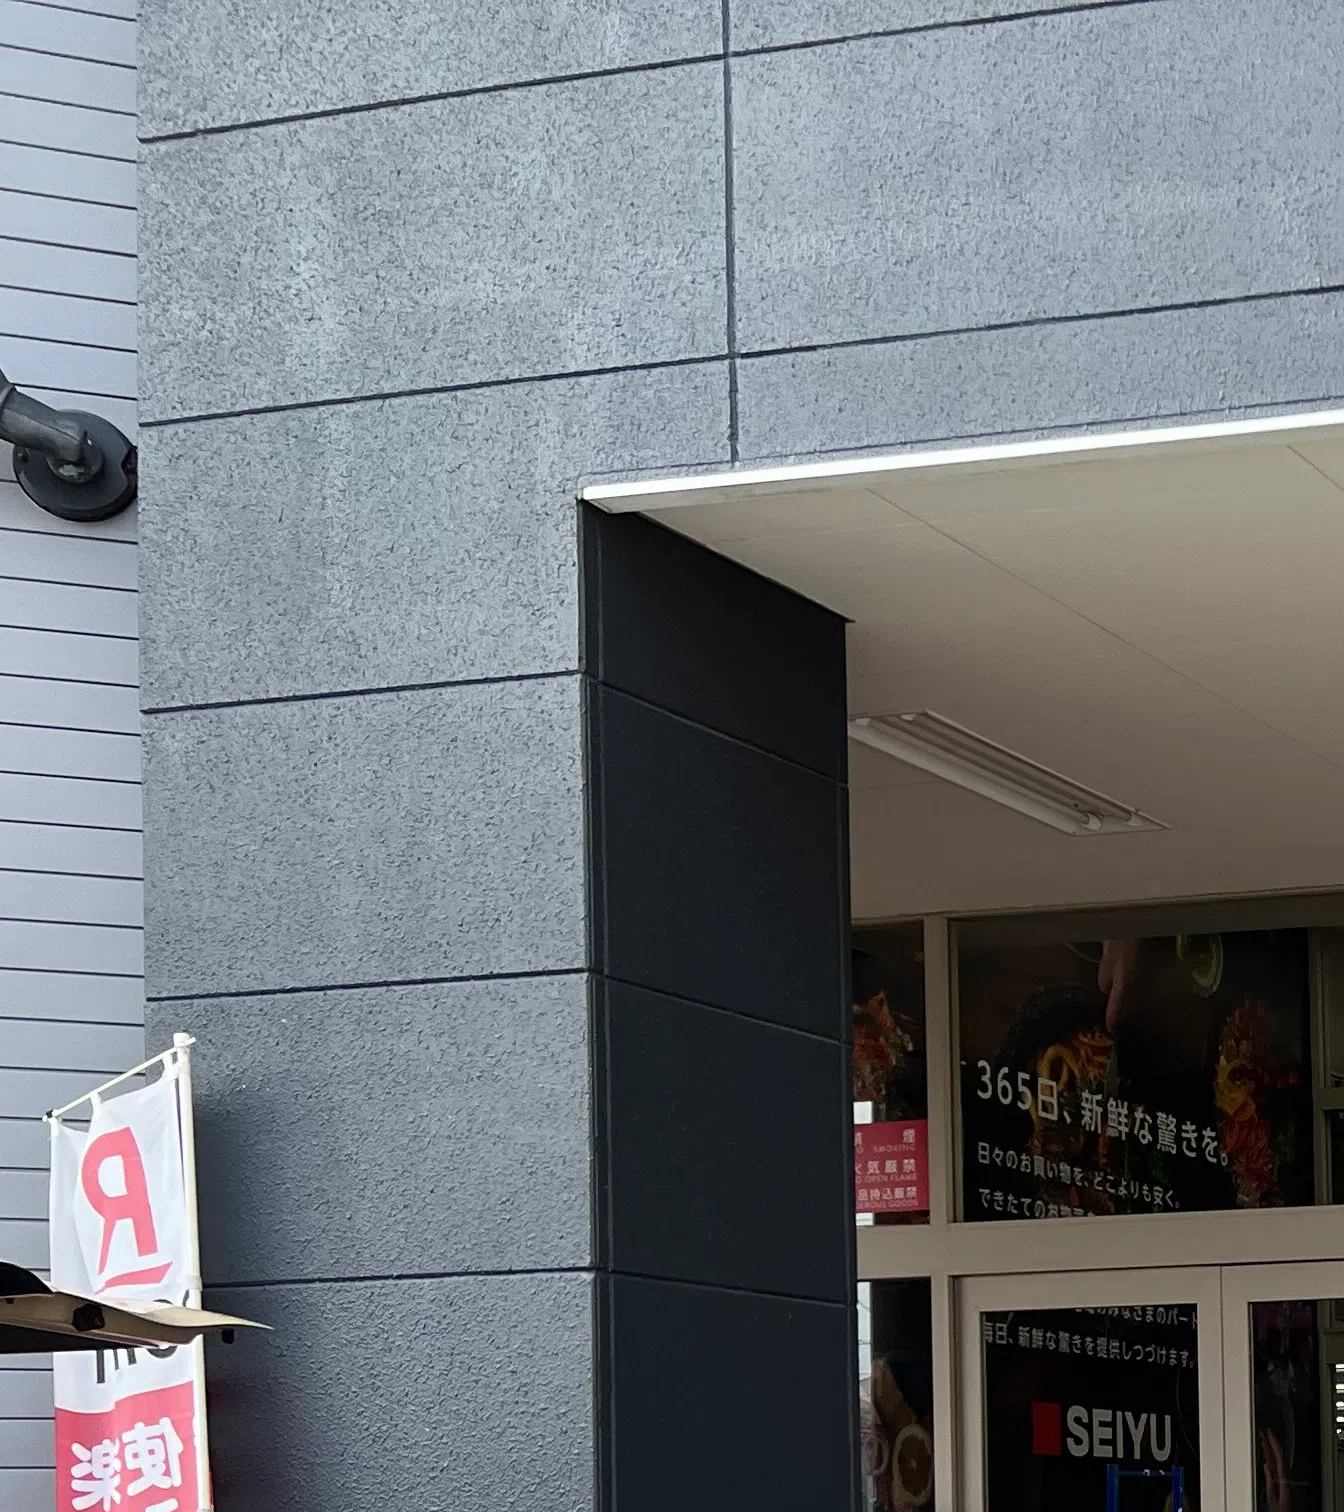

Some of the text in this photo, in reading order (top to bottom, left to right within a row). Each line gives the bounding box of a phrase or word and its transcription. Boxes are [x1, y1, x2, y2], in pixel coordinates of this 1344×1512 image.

[977, 1059, 1228, 1166] 365日、新鮮な驚きを。
[977, 1141, 1179, 1209] 日々のお買い物を、どこよりも安く。
[979, 1188, 1096, 1218] できたてのお
[1066, 1405, 1171, 1462] SEIYU
